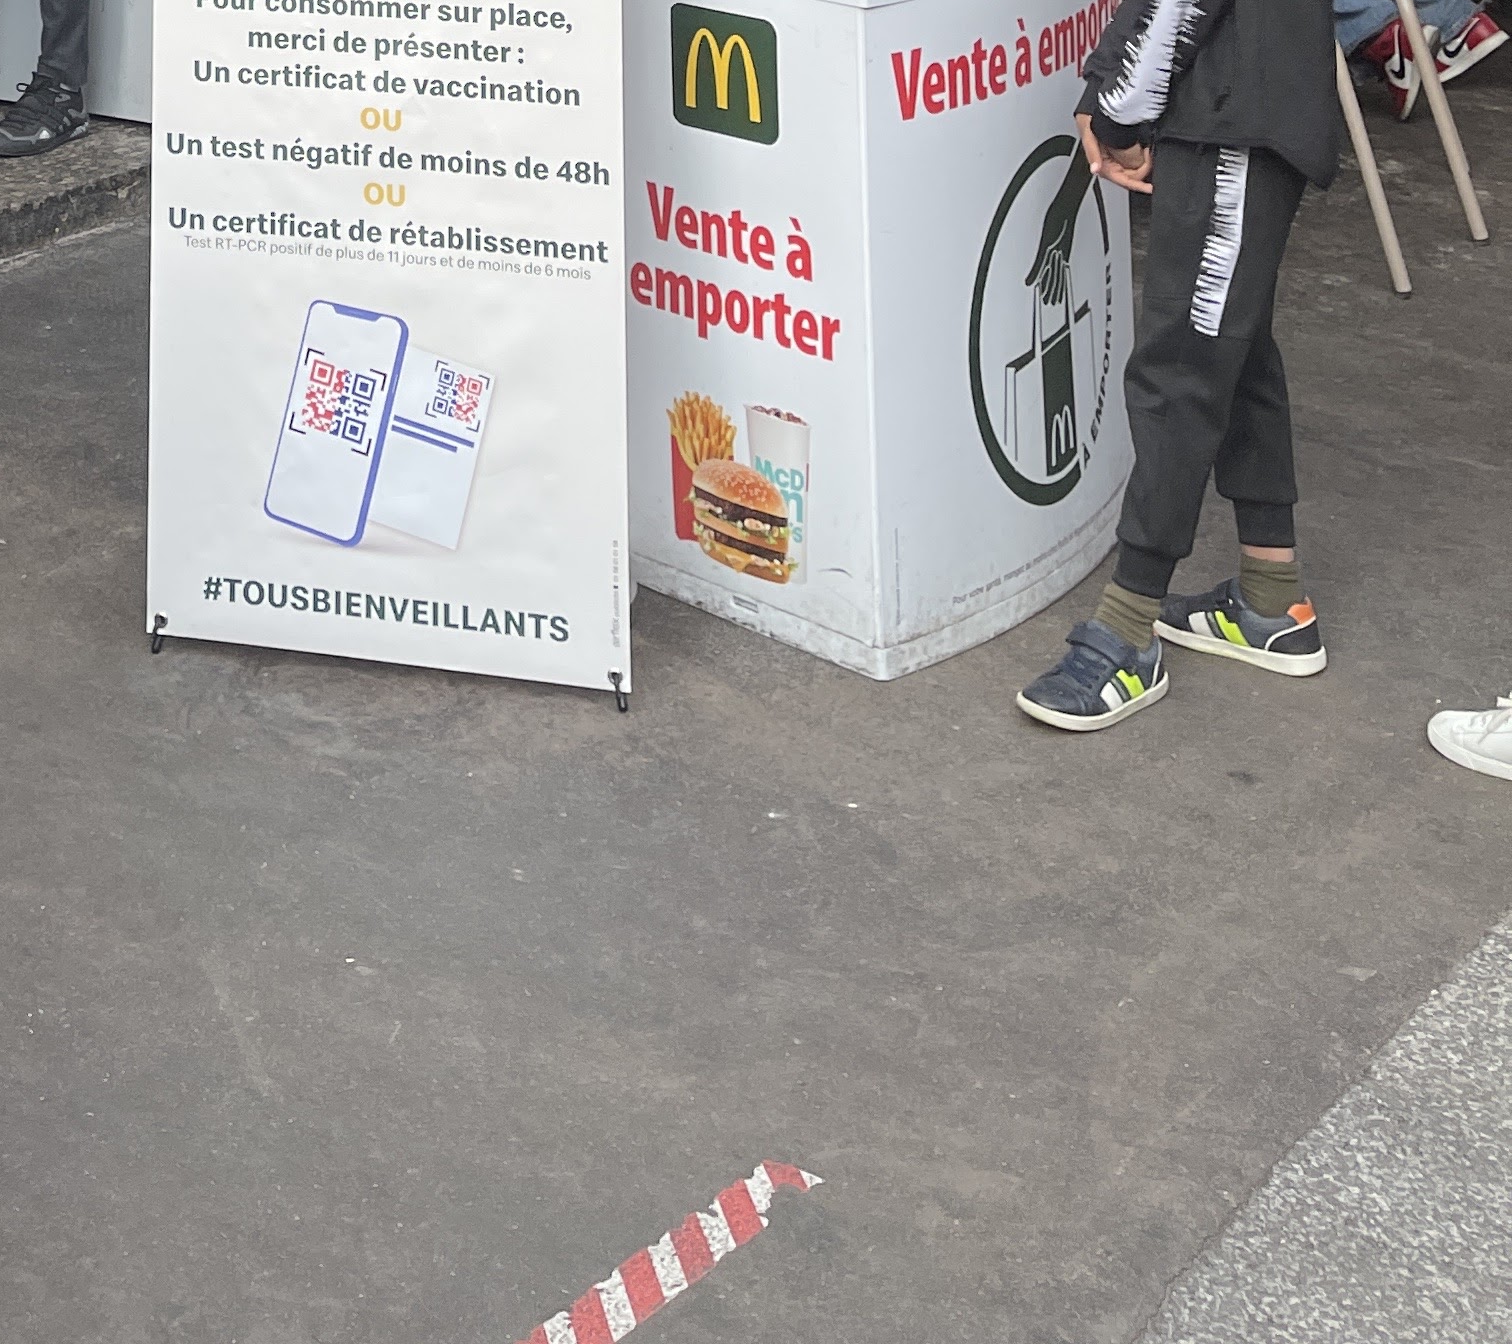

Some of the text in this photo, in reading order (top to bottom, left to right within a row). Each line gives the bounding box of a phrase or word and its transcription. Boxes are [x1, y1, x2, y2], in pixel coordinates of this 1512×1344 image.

[247, 28, 326, 52] merci
[333, 30, 367, 54] de
[374, 31, 511, 63] présenter
[437, 3, 483, 24] sur
[490, 2, 573, 34] place,
[194, 59, 581, 107] Un certificat de vaccination
[891, 37, 1008, 121] Vente
[1014, 17, 1033, 88] à
[360, 106, 402, 132] OU
[166, 131, 610, 186] Un test négatif de moins de 48h
[363, 182, 406, 207] OU
[168, 206, 610, 264] Un certificat de rétablissement
[184, 234, 592, 281] Test RT-PCR positif de plus de 11 jours et de moins de 6 mois
[645, 179, 814, 283] Vente à
[630, 261, 841, 362] emporter
[1090, 262, 1112, 443] EMPORTER
[202, 575, 570, 643] #TOUSBIENVEILLANTS
